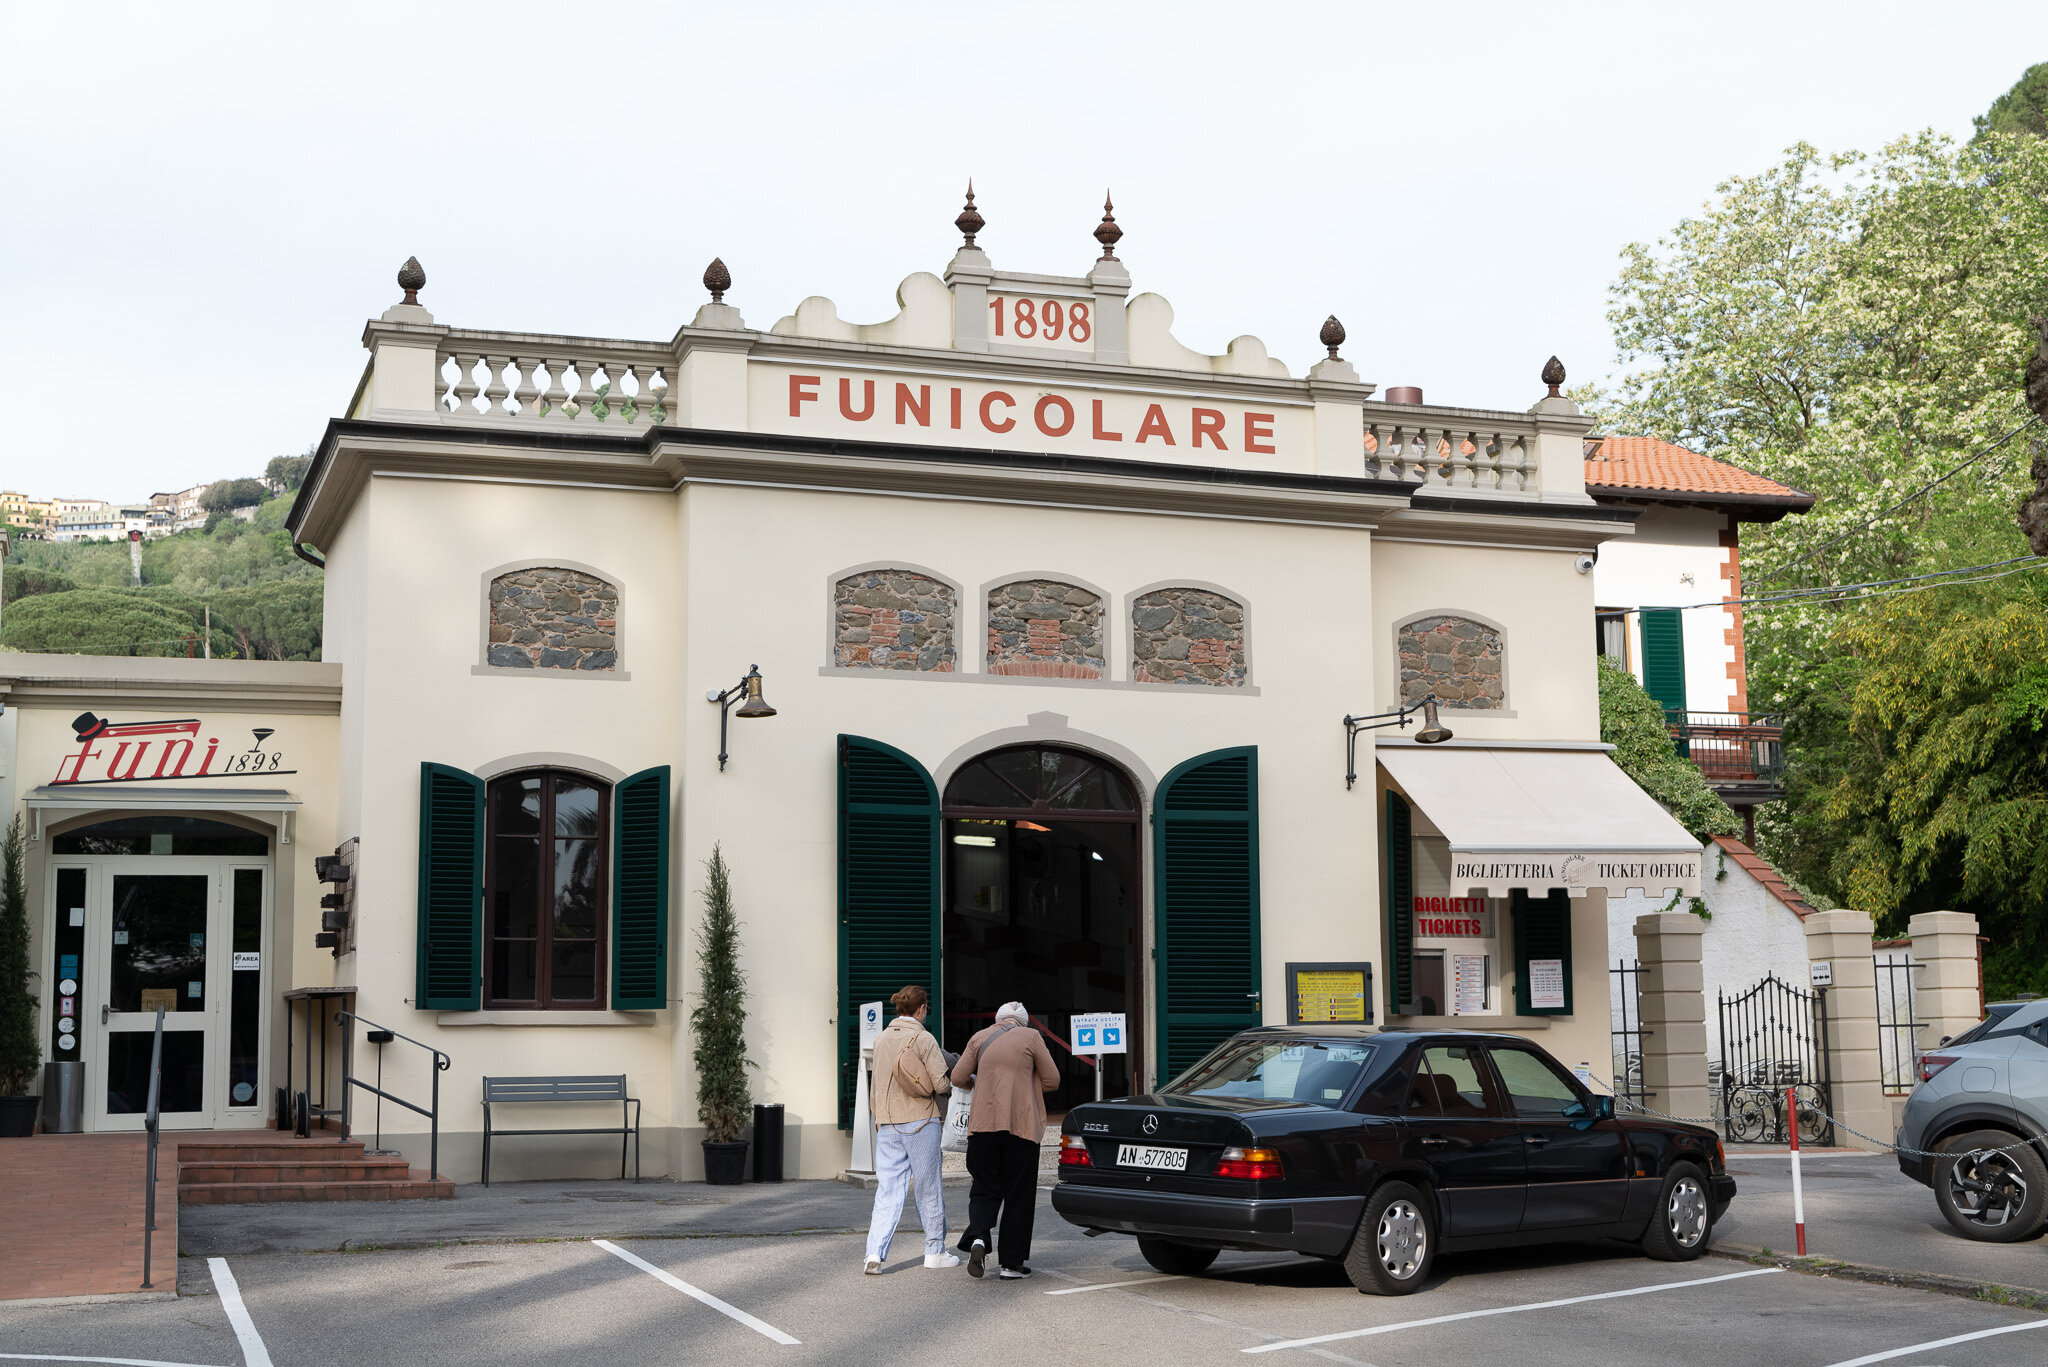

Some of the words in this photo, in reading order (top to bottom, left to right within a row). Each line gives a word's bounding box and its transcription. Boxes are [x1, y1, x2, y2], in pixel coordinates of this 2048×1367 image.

[989, 297, 1091, 343] 1898
[789, 375, 1276, 454] FUNICOLARE
[224, 752, 283, 773] 1898
[1456, 863, 1554, 879] BIGLIETTERIA
[1560, 854, 1586, 883] FUNICOLARE
[1597, 863, 1647, 879] TICKET
[1649, 863, 1696, 878] OFFICE
[1414, 896, 1485, 913] BIGLIETTI
[1418, 918, 1481, 935] TICKETS
[1119, 1147, 1138, 1164] AN
[1143, 1149, 1187, 1168] 577805
